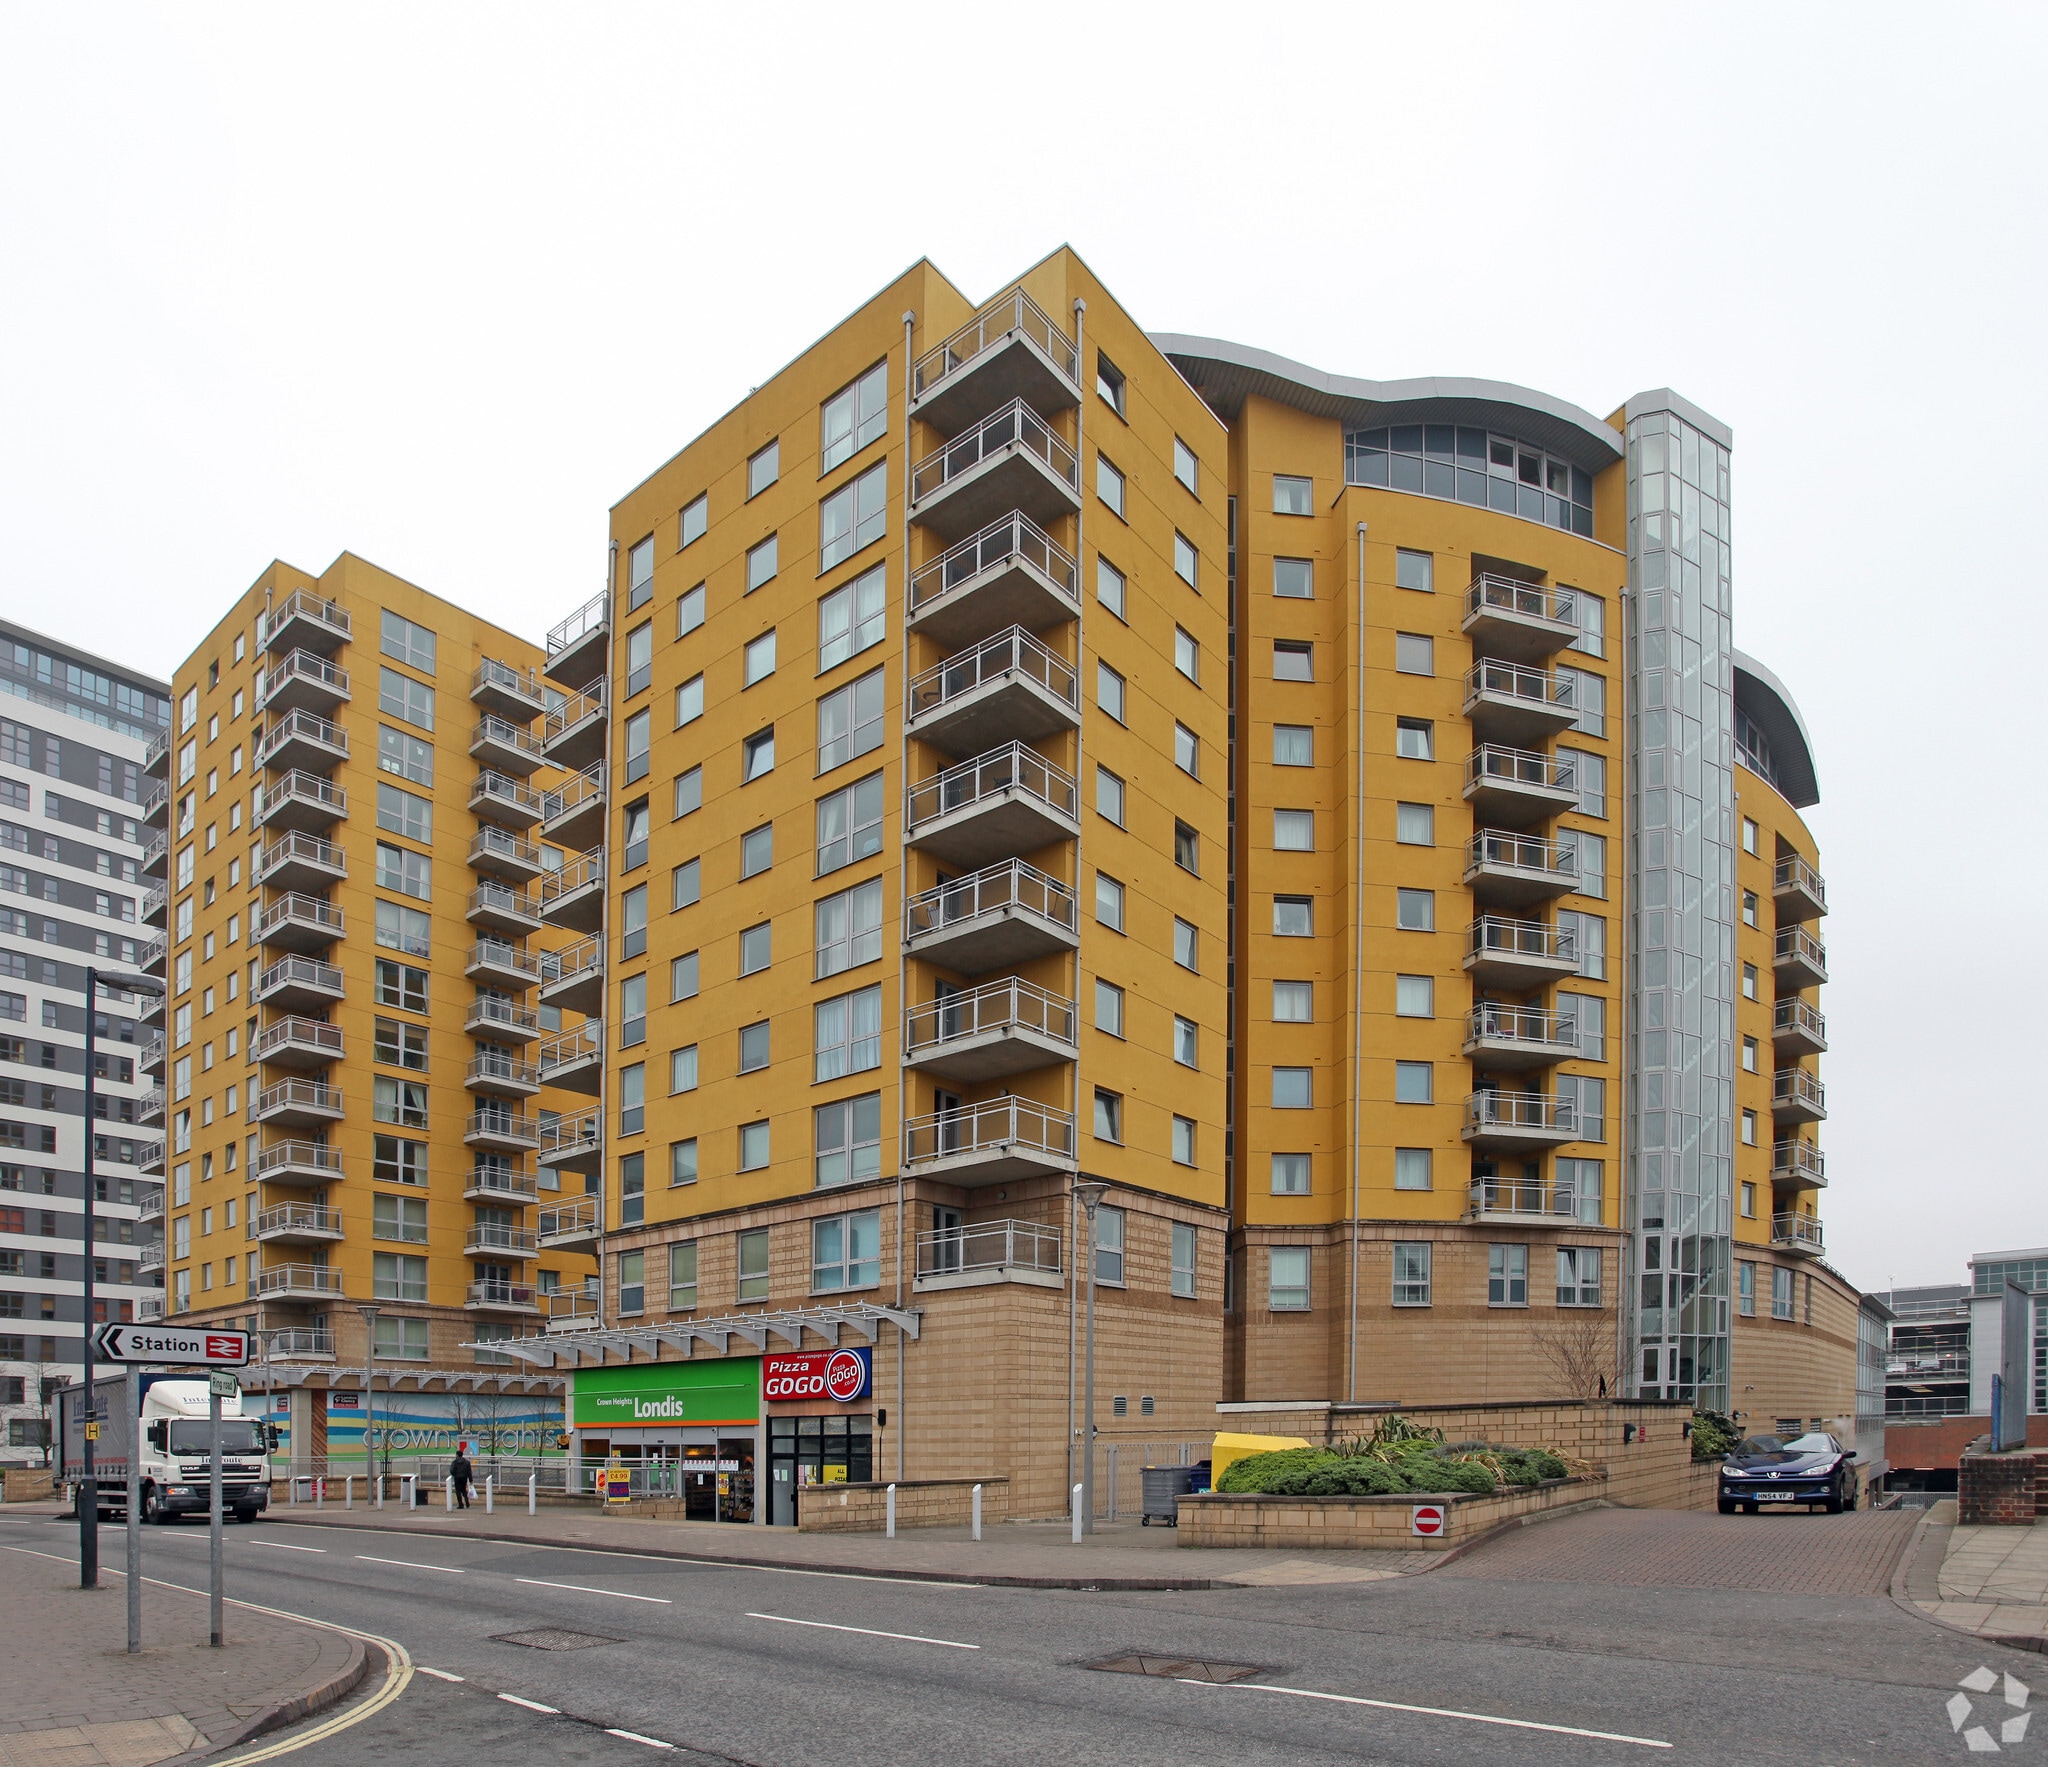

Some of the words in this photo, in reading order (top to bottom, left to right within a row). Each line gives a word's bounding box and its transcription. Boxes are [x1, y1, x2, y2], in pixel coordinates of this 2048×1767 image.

[131, 1336, 200, 1352] Station
[769, 1361, 810, 1373] Pizza
[830, 1365, 858, 1385] GOGO
[832, 1364, 846, 1373] Pizza
[213, 1376, 222, 1391] Ring
[223, 1380, 233, 1390] road
[766, 1375, 825, 1395] GOGO
[597, 1398, 612, 1406] Crown
[613, 1397, 633, 1407] Heights
[634, 1395, 684, 1418] Londis
[88, 1424, 99, 1438] H
[363, 1428, 450, 1450] crown
